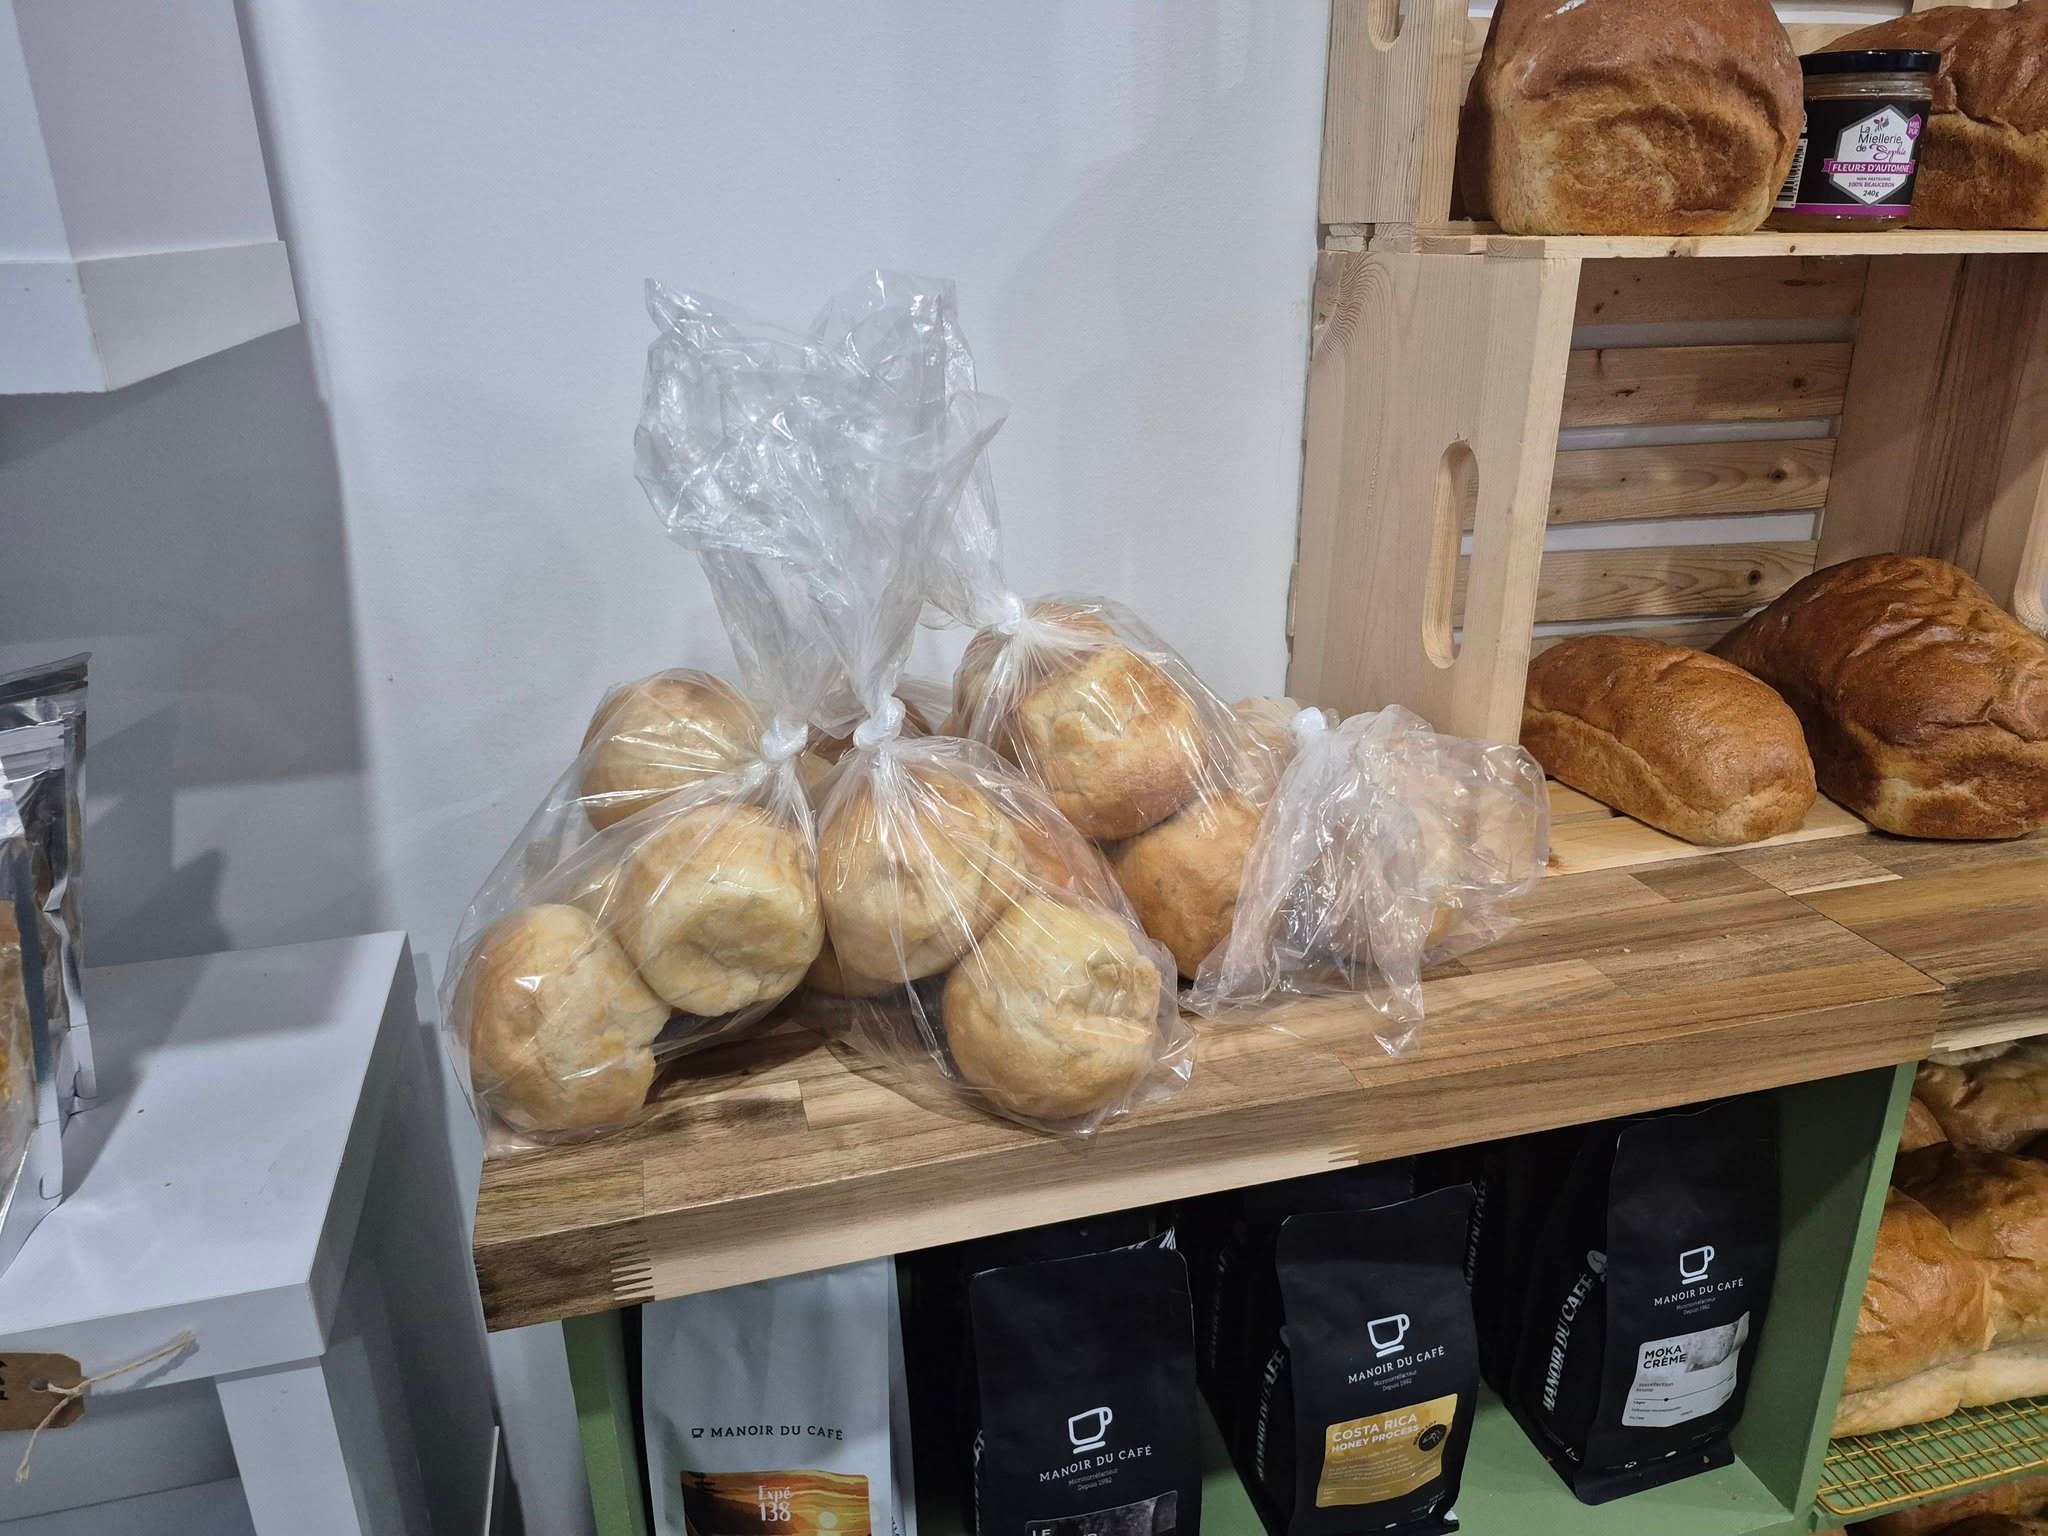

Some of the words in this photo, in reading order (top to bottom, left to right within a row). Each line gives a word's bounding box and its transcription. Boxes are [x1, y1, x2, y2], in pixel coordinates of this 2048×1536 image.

[1860, 125, 1871, 134] La
[1908, 127, 1919, 135] PUR
[1857, 133, 1902, 144] Miellerie
[1855, 143, 1867, 153] de
[1869, 140, 1906, 162] Sophie
[1832, 163, 1866, 172] FLEURS
[1867, 164, 1910, 173] D'AUTOMNE
[1862, 189, 1880, 198] 240g
[1561, 1272, 1594, 1322] CAFÉ
[1653, 1289, 1696, 1307] MANOIR
[1699, 1284, 1714, 1295] DU
[1717, 1278, 1745, 1292] CAFÉ
[1554, 1317, 1571, 1350] DU
[1643, 1353, 1688, 1369] CRÈME
[1644, 1345, 1682, 1360] MOKA
[1348, 1362, 1394, 1384] MANOIR
[1396, 1356, 1414, 1369] DU
[1416, 1345, 1445, 1363] CAFÉ
[1382, 1382, 1399, 1392] Depuis
[711, 1425, 774, 1438] MANOIR
[780, 1425, 801, 1436] DU
[807, 1425, 844, 1441] CAFÉ
[1332, 1423, 1380, 1442] COSTA
[1384, 1413, 1418, 1430] RICA
[1331, 1437, 1370, 1453] HONEY
[1371, 1424, 1419, 1443] PROCESS
[1039, 1459, 1092, 1482] MANOIR
[1096, 1452, 1114, 1466] DU
[1118, 1444, 1153, 1461] CAFÉ
[757, 1485, 793, 1503] Expé
[1077, 1482, 1098, 1491] Depuis
[758, 1502, 792, 1522] 138
